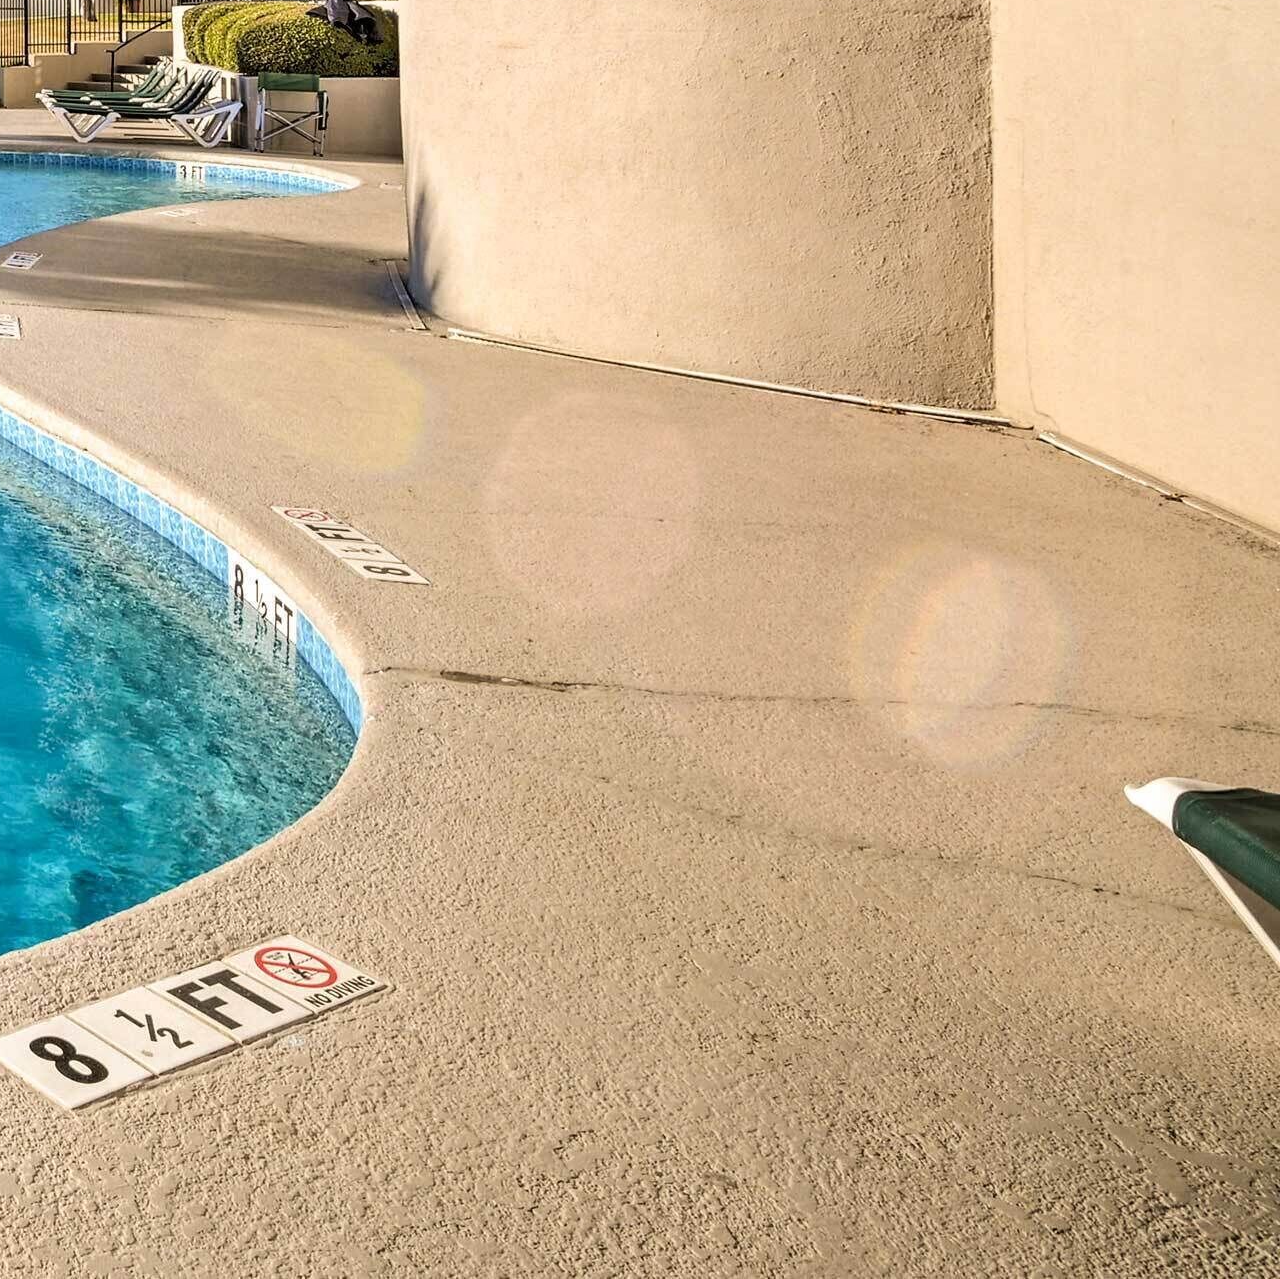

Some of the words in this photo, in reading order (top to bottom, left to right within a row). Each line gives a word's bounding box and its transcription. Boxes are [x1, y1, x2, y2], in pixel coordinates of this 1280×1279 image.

[180, 165, 187, 179] 3
[191, 165, 203, 180] FT
[304, 523, 365, 542] FT
[234, 564, 244, 602] 8
[274, 595, 294, 642] FT
[304, 992, 332, 1008] NO
[324, 975, 376, 999] DIVING
[28, 1034, 109, 1085] 8
[166, 968, 285, 1030] FT
